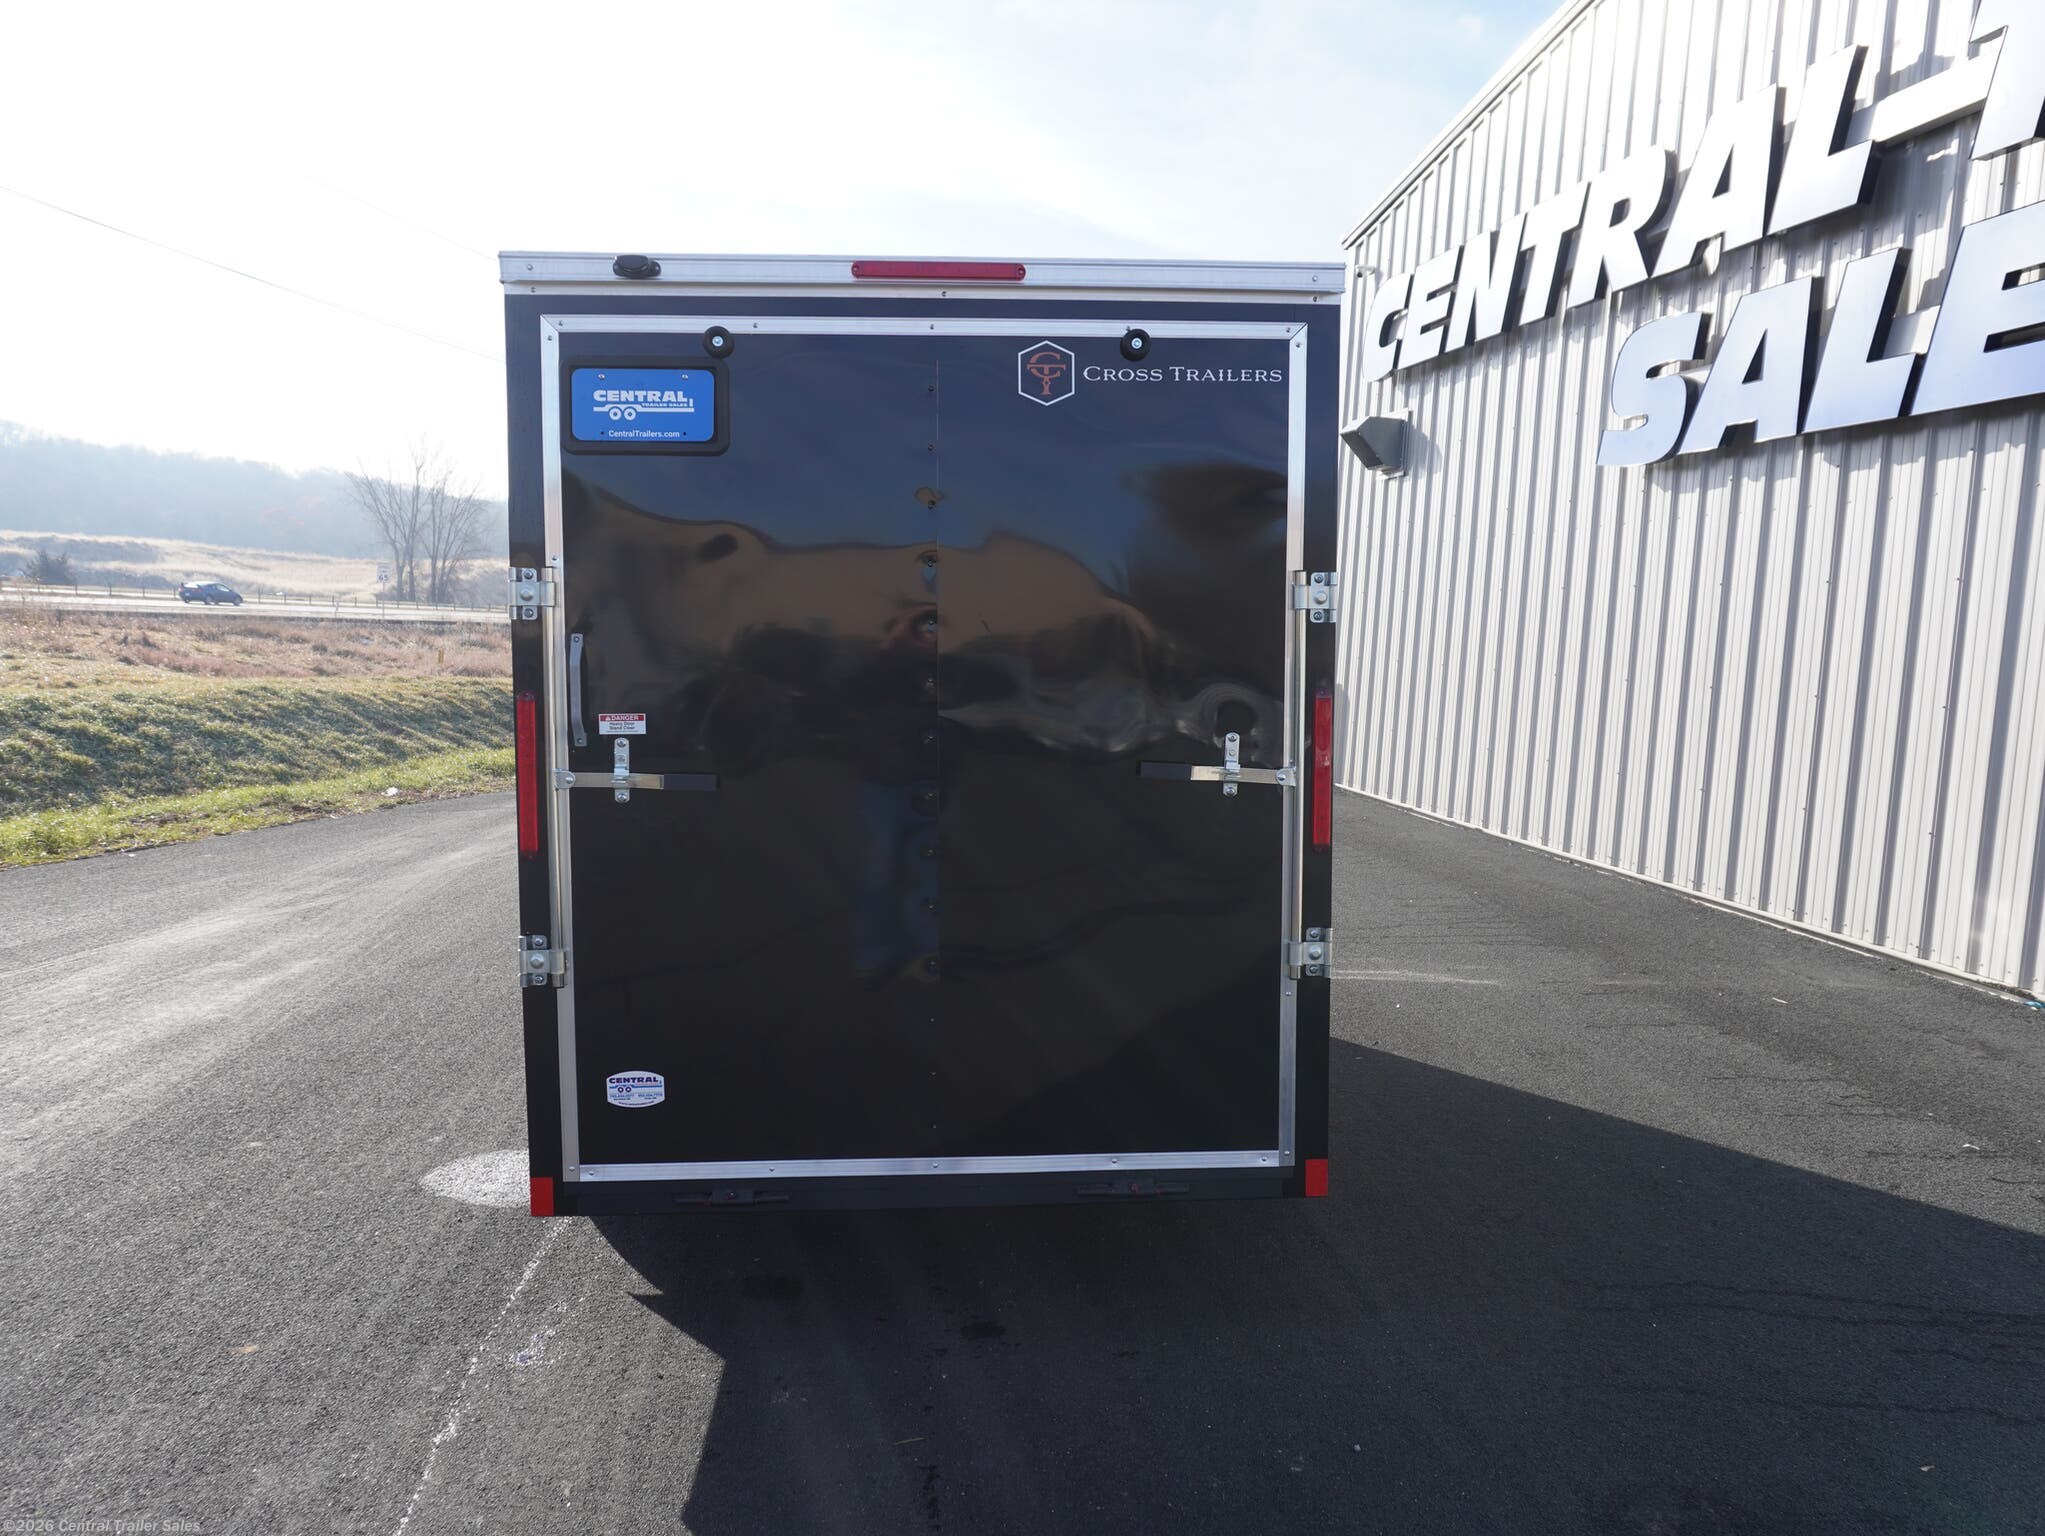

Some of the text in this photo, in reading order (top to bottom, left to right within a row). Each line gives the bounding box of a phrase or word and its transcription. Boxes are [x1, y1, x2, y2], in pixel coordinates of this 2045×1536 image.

[1361, 44, 1875, 382] CENTRAL
[593, 389, 688, 402] CENTRAL
[608, 430, 680, 438] CentralTrailers.com
[608, 1076, 659, 1084] CENTRAL
